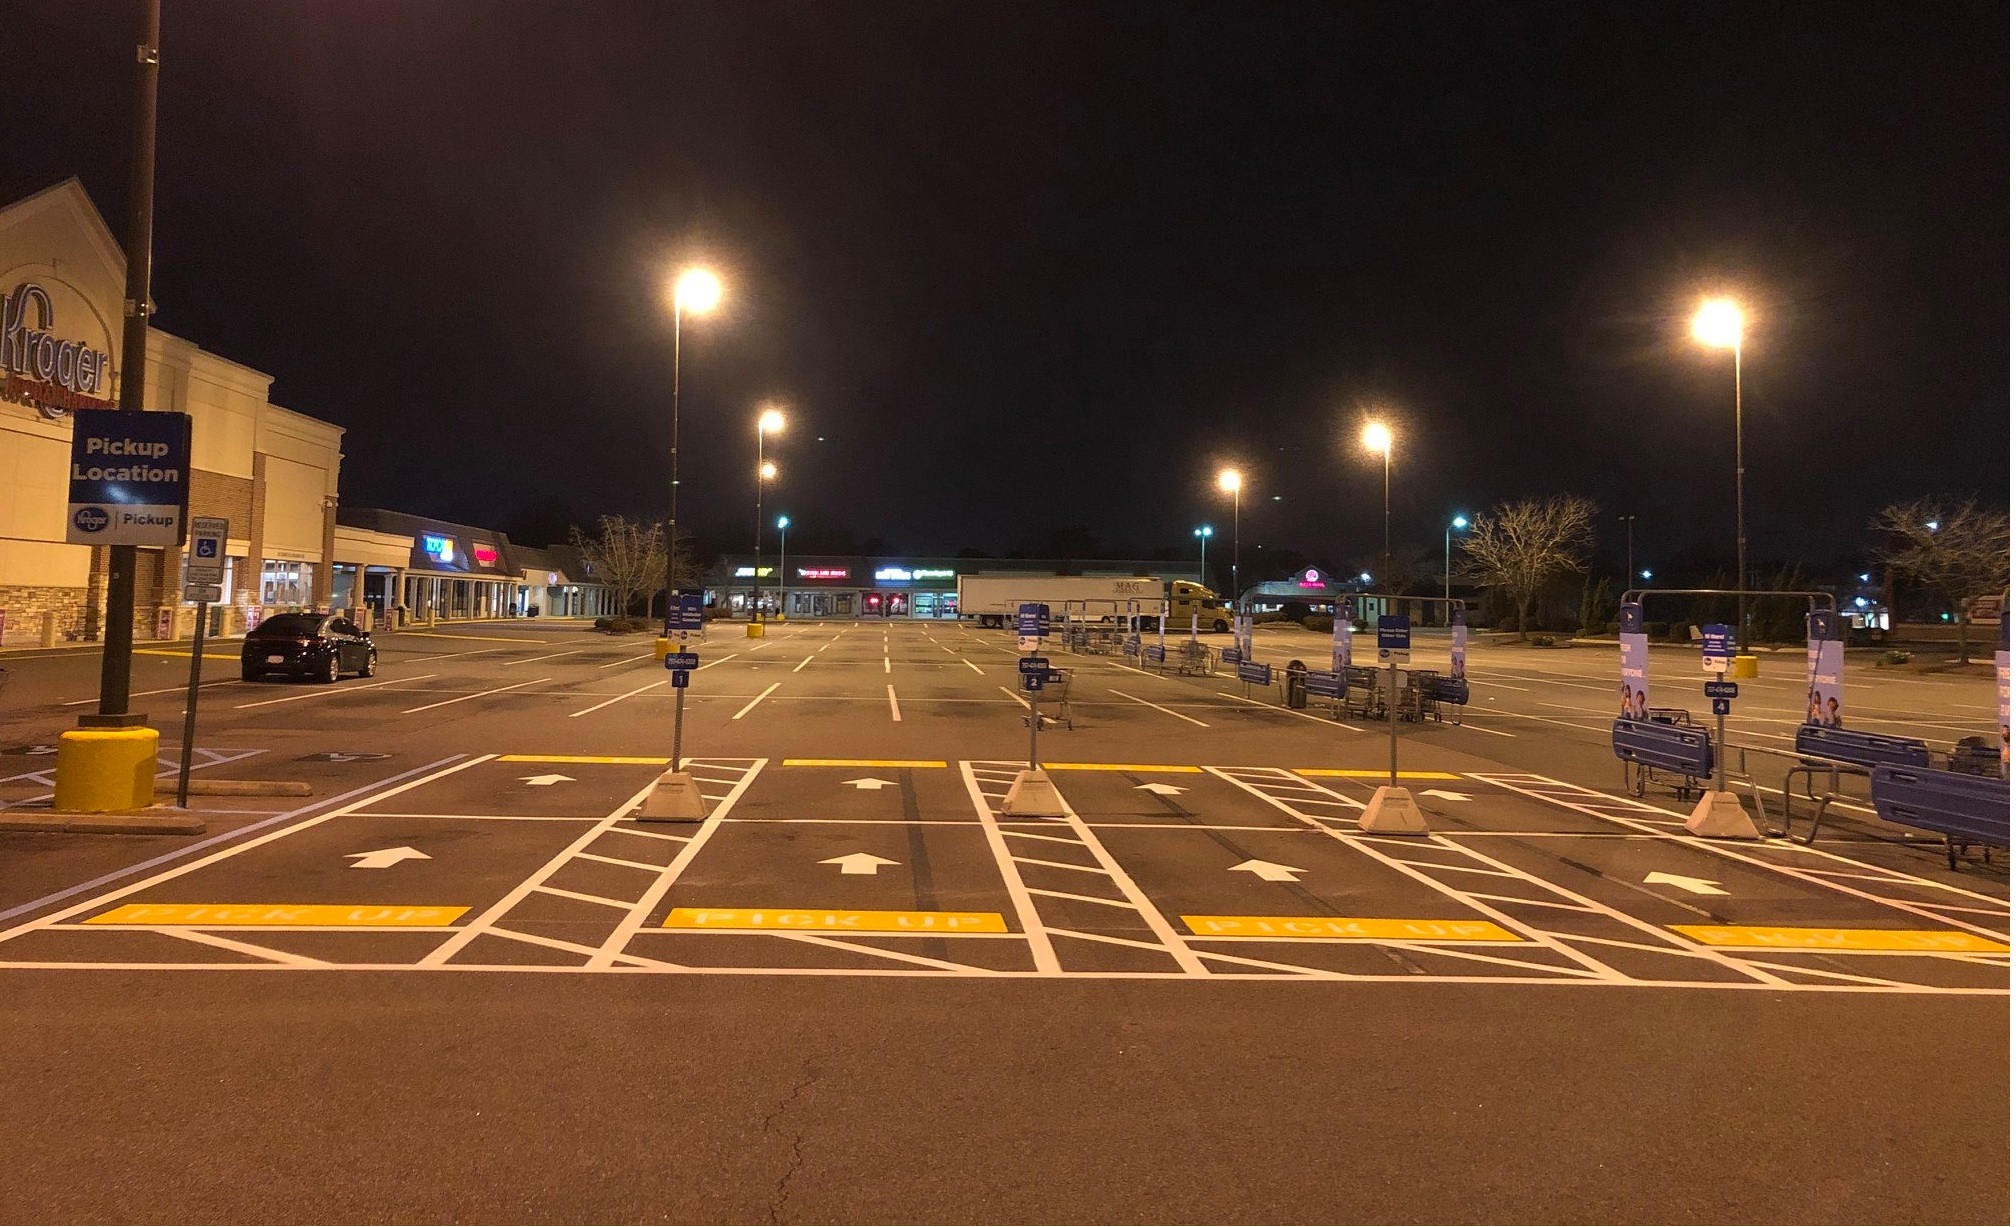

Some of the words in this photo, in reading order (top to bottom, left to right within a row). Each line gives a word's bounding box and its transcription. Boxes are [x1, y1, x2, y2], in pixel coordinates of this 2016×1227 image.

[0, 283, 108, 418] Kroger
[87, 437, 169, 459] Pickup
[72, 463, 179, 482] Location
[123, 513, 174, 527] Pickup
[1030, 678, 1038, 687] 2
[1717, 702, 1725, 711] 4
[124, 907, 314, 922] PICK
[346, 909, 443, 922] UP
[694, 912, 861, 926] PICK
[896, 914, 983, 928] UP
[1204, 919, 1371, 934] PICK
[1403, 923, 1489, 936] UP
